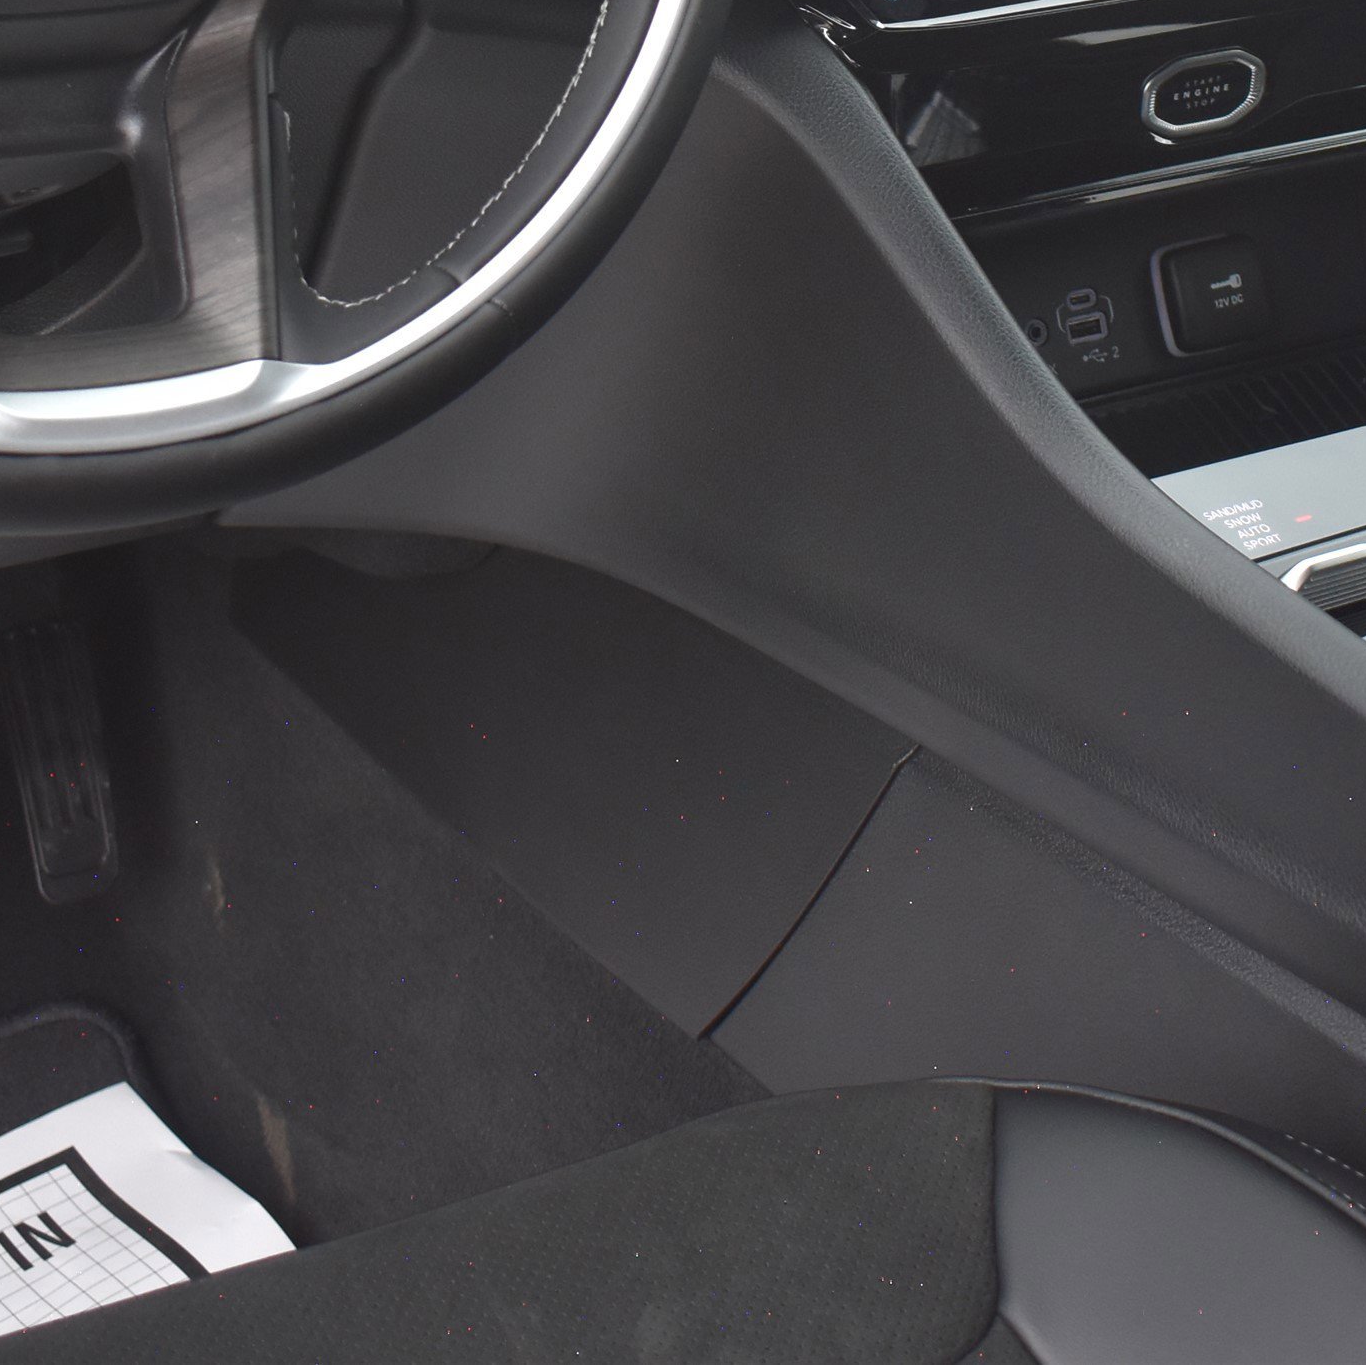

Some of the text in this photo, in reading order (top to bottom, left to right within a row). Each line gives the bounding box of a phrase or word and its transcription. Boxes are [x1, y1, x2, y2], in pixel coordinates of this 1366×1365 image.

[1173, 83, 1230, 101] ENGINE
[1186, 98, 1216, 109] STOP
[1214, 294, 1244, 309] 12V DC
[1203, 499, 1263, 521] SAND/MUD
[1224, 512, 1262, 529] SNOW
[1237, 523, 1270, 539] AUTO
[1243, 533, 1282, 550] SPORT
